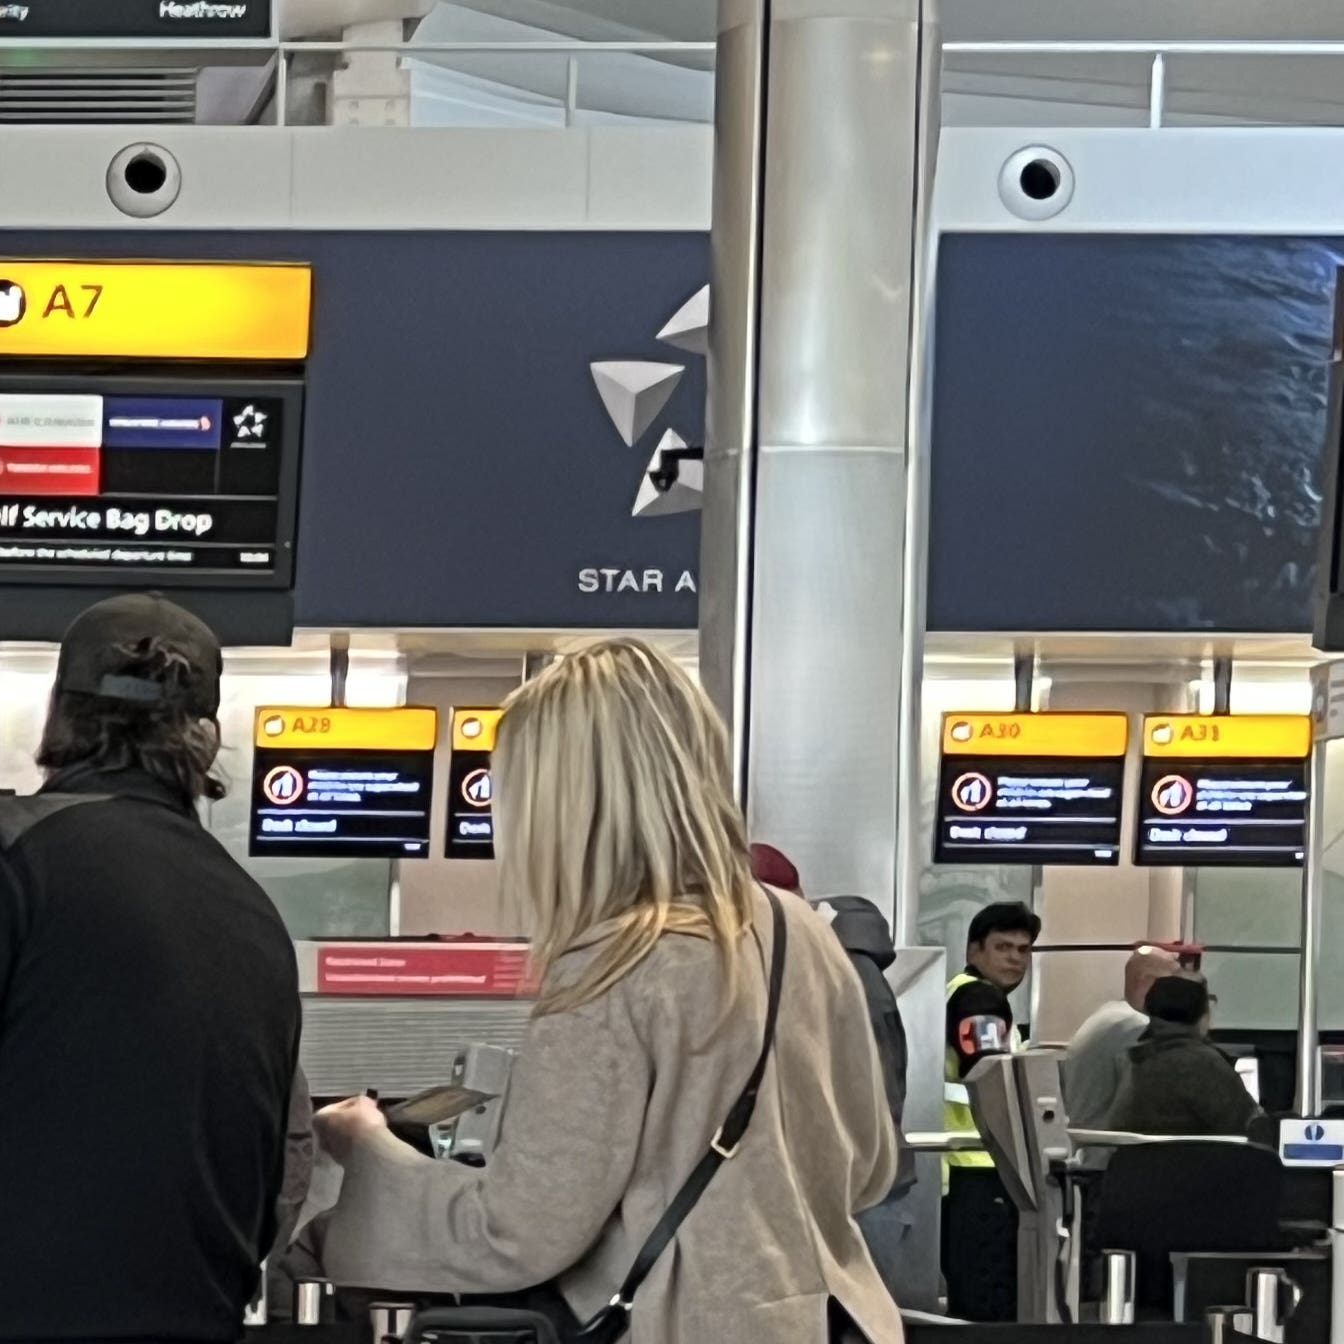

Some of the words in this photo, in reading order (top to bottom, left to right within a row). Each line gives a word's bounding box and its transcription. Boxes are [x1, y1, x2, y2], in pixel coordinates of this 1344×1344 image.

[159, 0, 247, 18] Heathrow
[42, 284, 104, 319] A7
[22, 506, 101, 528] Service
[105, 508, 150, 535] Bag
[154, 509, 212, 536] Drop
[577, 568, 663, 593] STAR
[291, 717, 332, 734] A28
